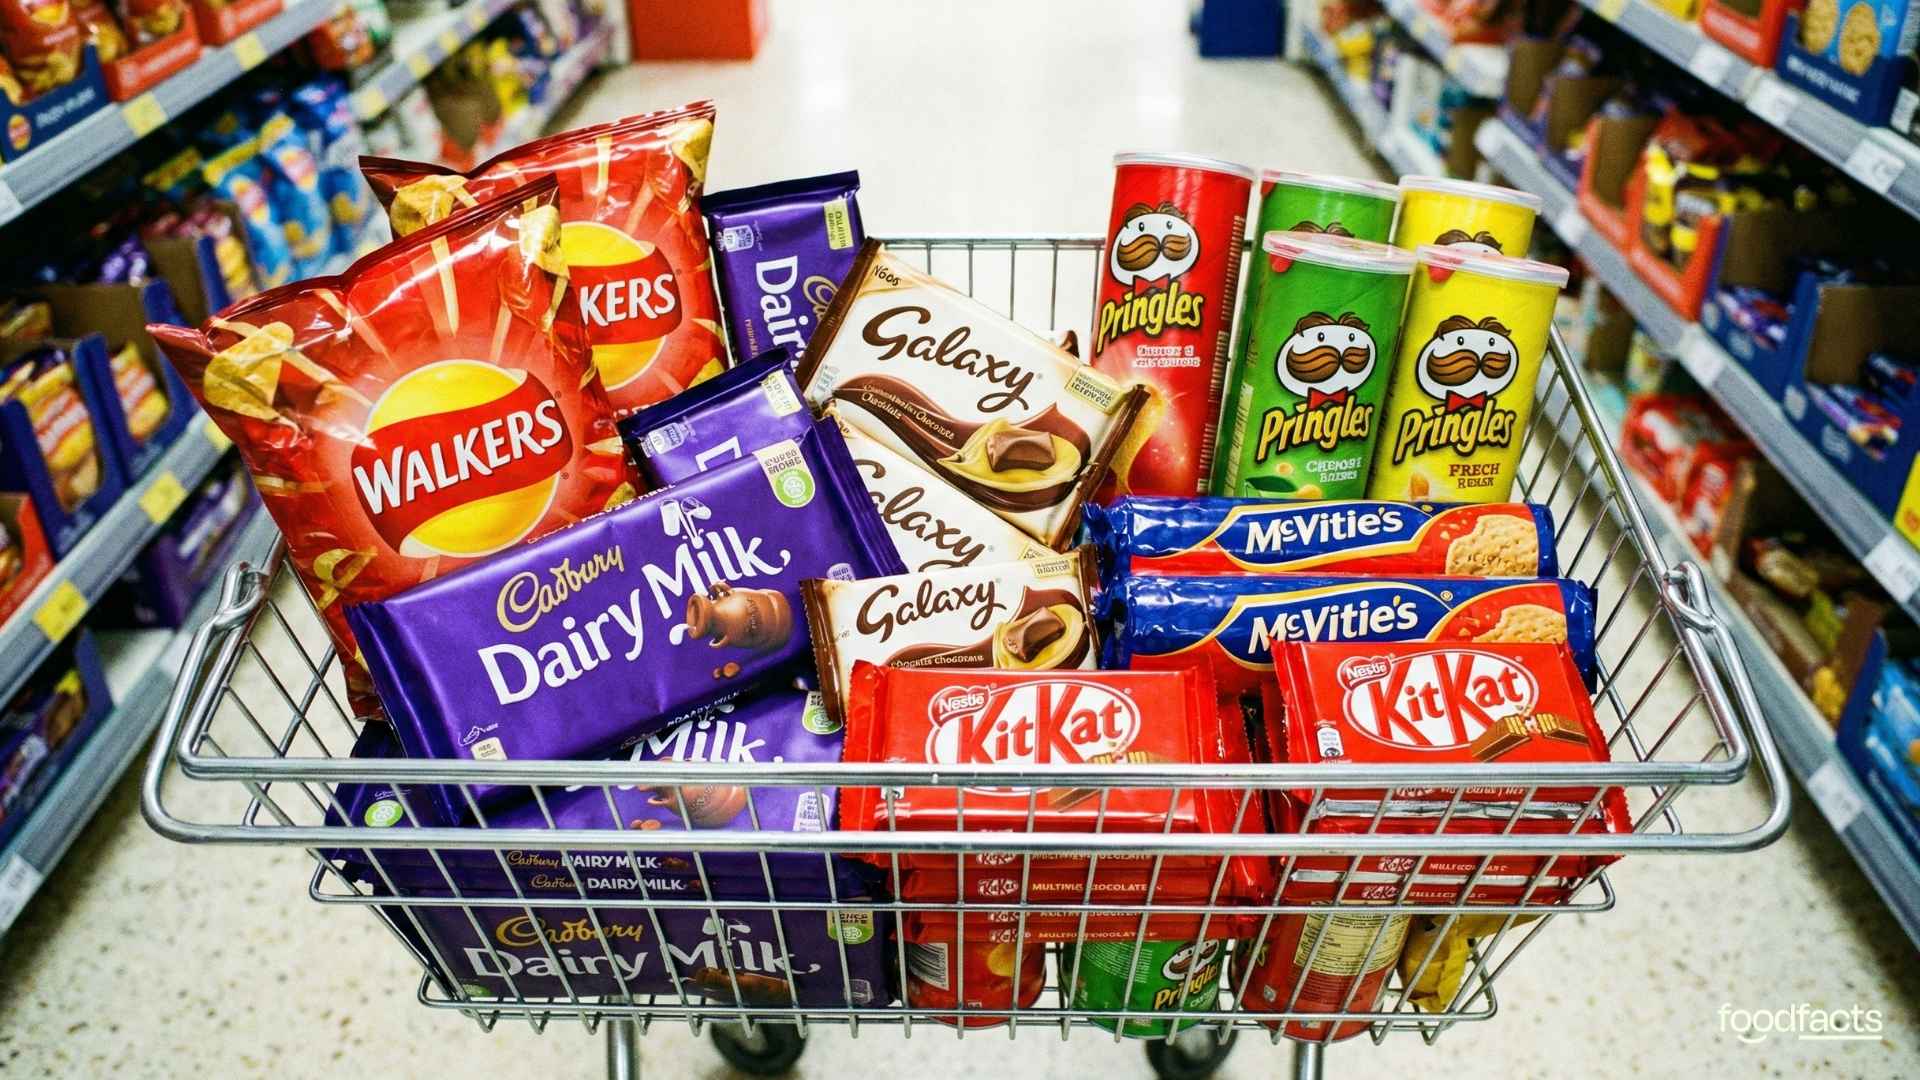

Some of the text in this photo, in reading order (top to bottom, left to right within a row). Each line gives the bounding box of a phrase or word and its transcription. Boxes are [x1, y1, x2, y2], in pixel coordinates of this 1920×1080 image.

[579, 273, 676, 327] KERS
[1096, 281, 1204, 356] Pringles
[862, 305, 1034, 413] Galaxy
[353, 399, 563, 515] WALKERS
[1257, 394, 1373, 463] Pringles
[1393, 396, 1516, 465] Pringles
[1245, 506, 1404, 554] McVitie's
[477, 526, 785, 706] Dairy Milk
[496, 545, 625, 633] Cadbury
[855, 578, 1007, 644] Galaxy
[1248, 594, 1420, 655] McVitie's
[956, 683, 1124, 764] KitKat
[1368, 652, 1524, 746] KitKat
[530, 873, 685, 891] Cadbu DAIRY MILK
[615, 856, 659, 869] MLK
[464, 948, 648, 981] Dairy
